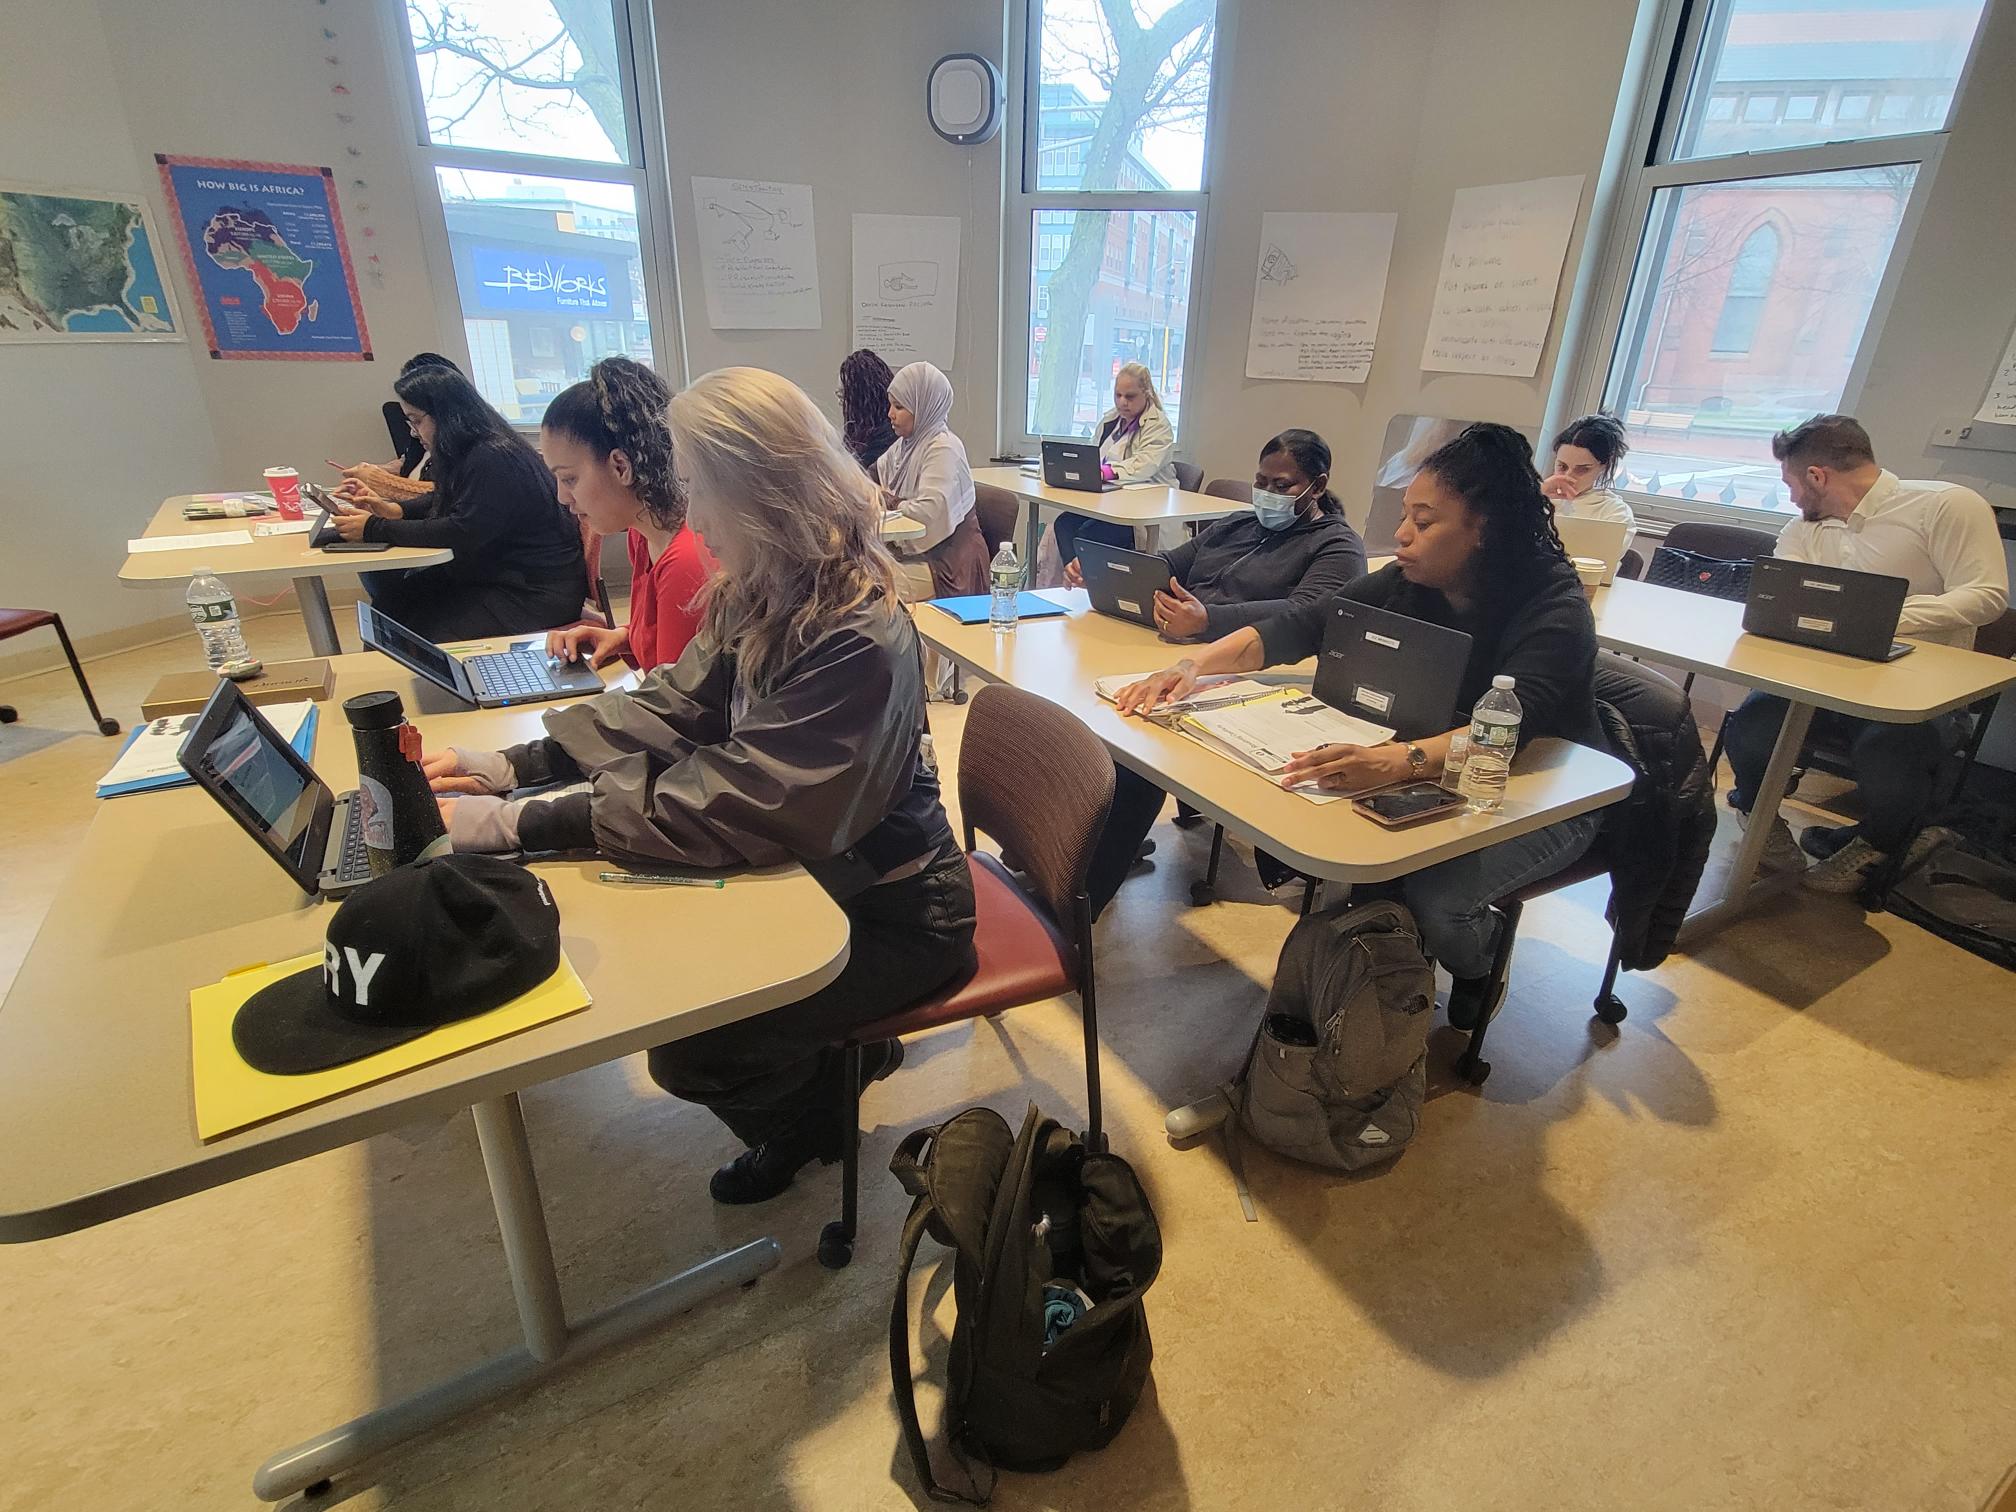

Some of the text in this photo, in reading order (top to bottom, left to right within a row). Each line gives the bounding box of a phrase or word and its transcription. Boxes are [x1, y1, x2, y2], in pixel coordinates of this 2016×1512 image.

[196, 179, 305, 196] HOW BIG IS AFRICA?
